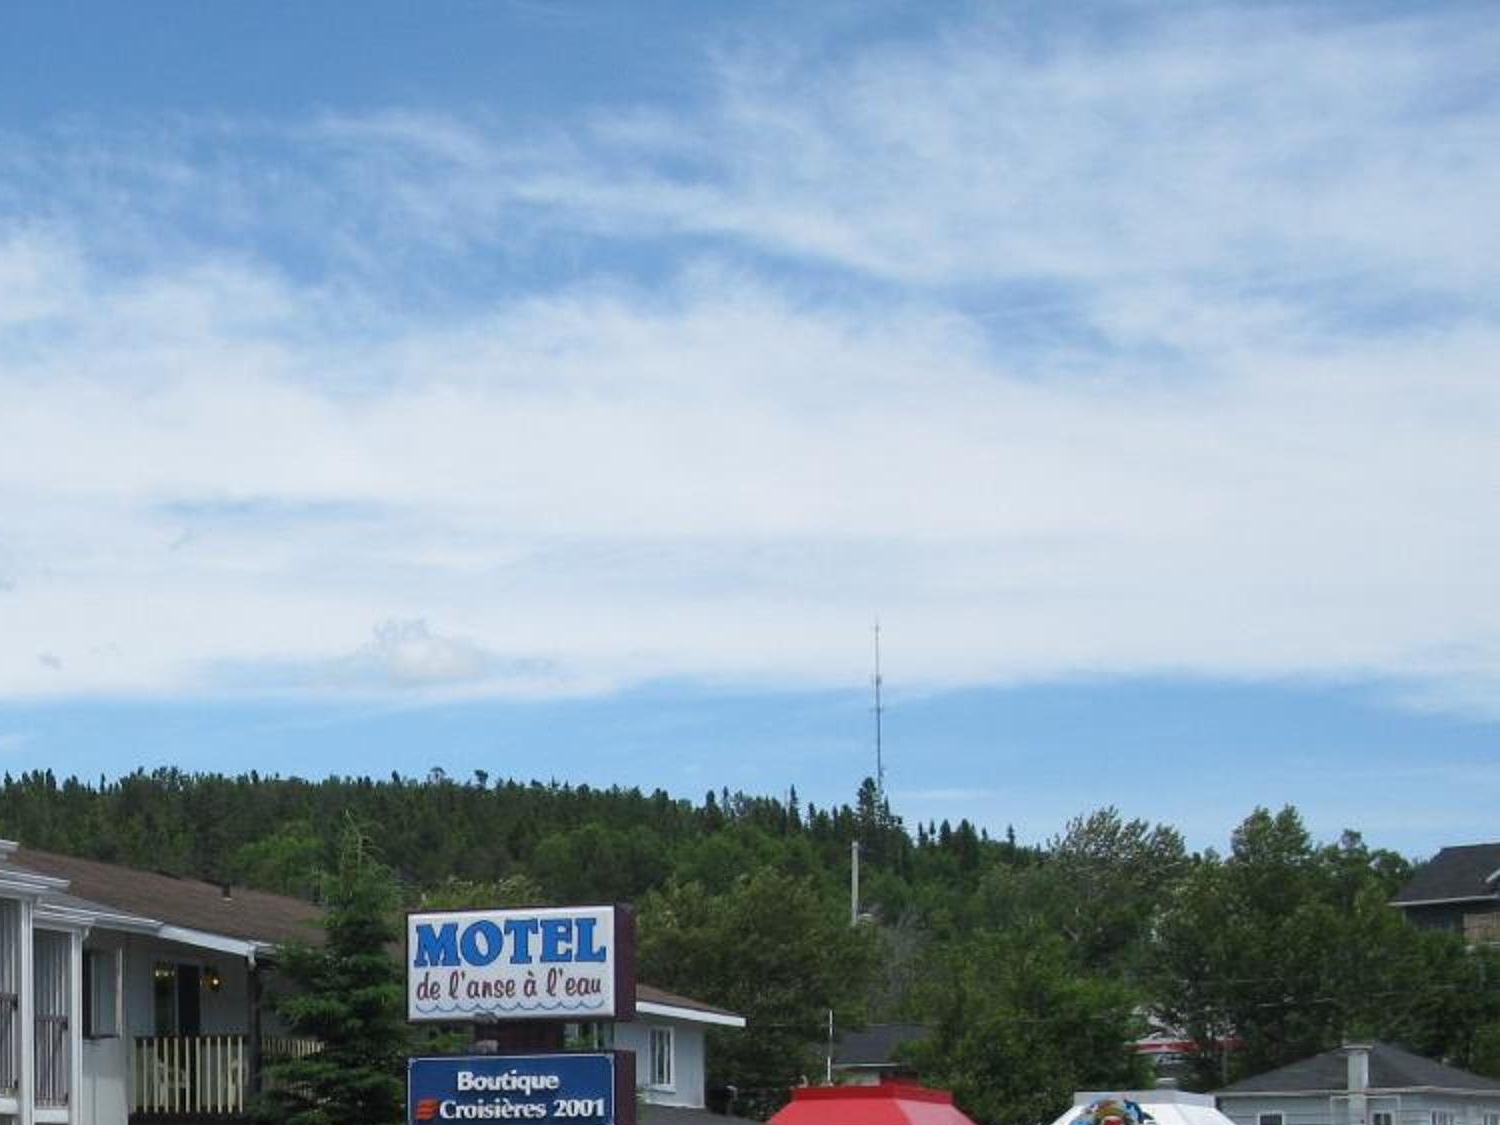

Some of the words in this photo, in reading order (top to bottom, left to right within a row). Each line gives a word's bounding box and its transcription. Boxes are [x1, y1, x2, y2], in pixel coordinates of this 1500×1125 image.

[413, 917, 608, 968] MOTEL
[416, 972, 441, 1001] de
[450, 970, 516, 999] l'anse
[523, 970, 538, 997] à
[545, 967, 603, 997] l'eau
[457, 1069, 560, 1096] Boutique
[439, 1098, 547, 1120] Croisières
[553, 1098, 605, 1118] 2001
